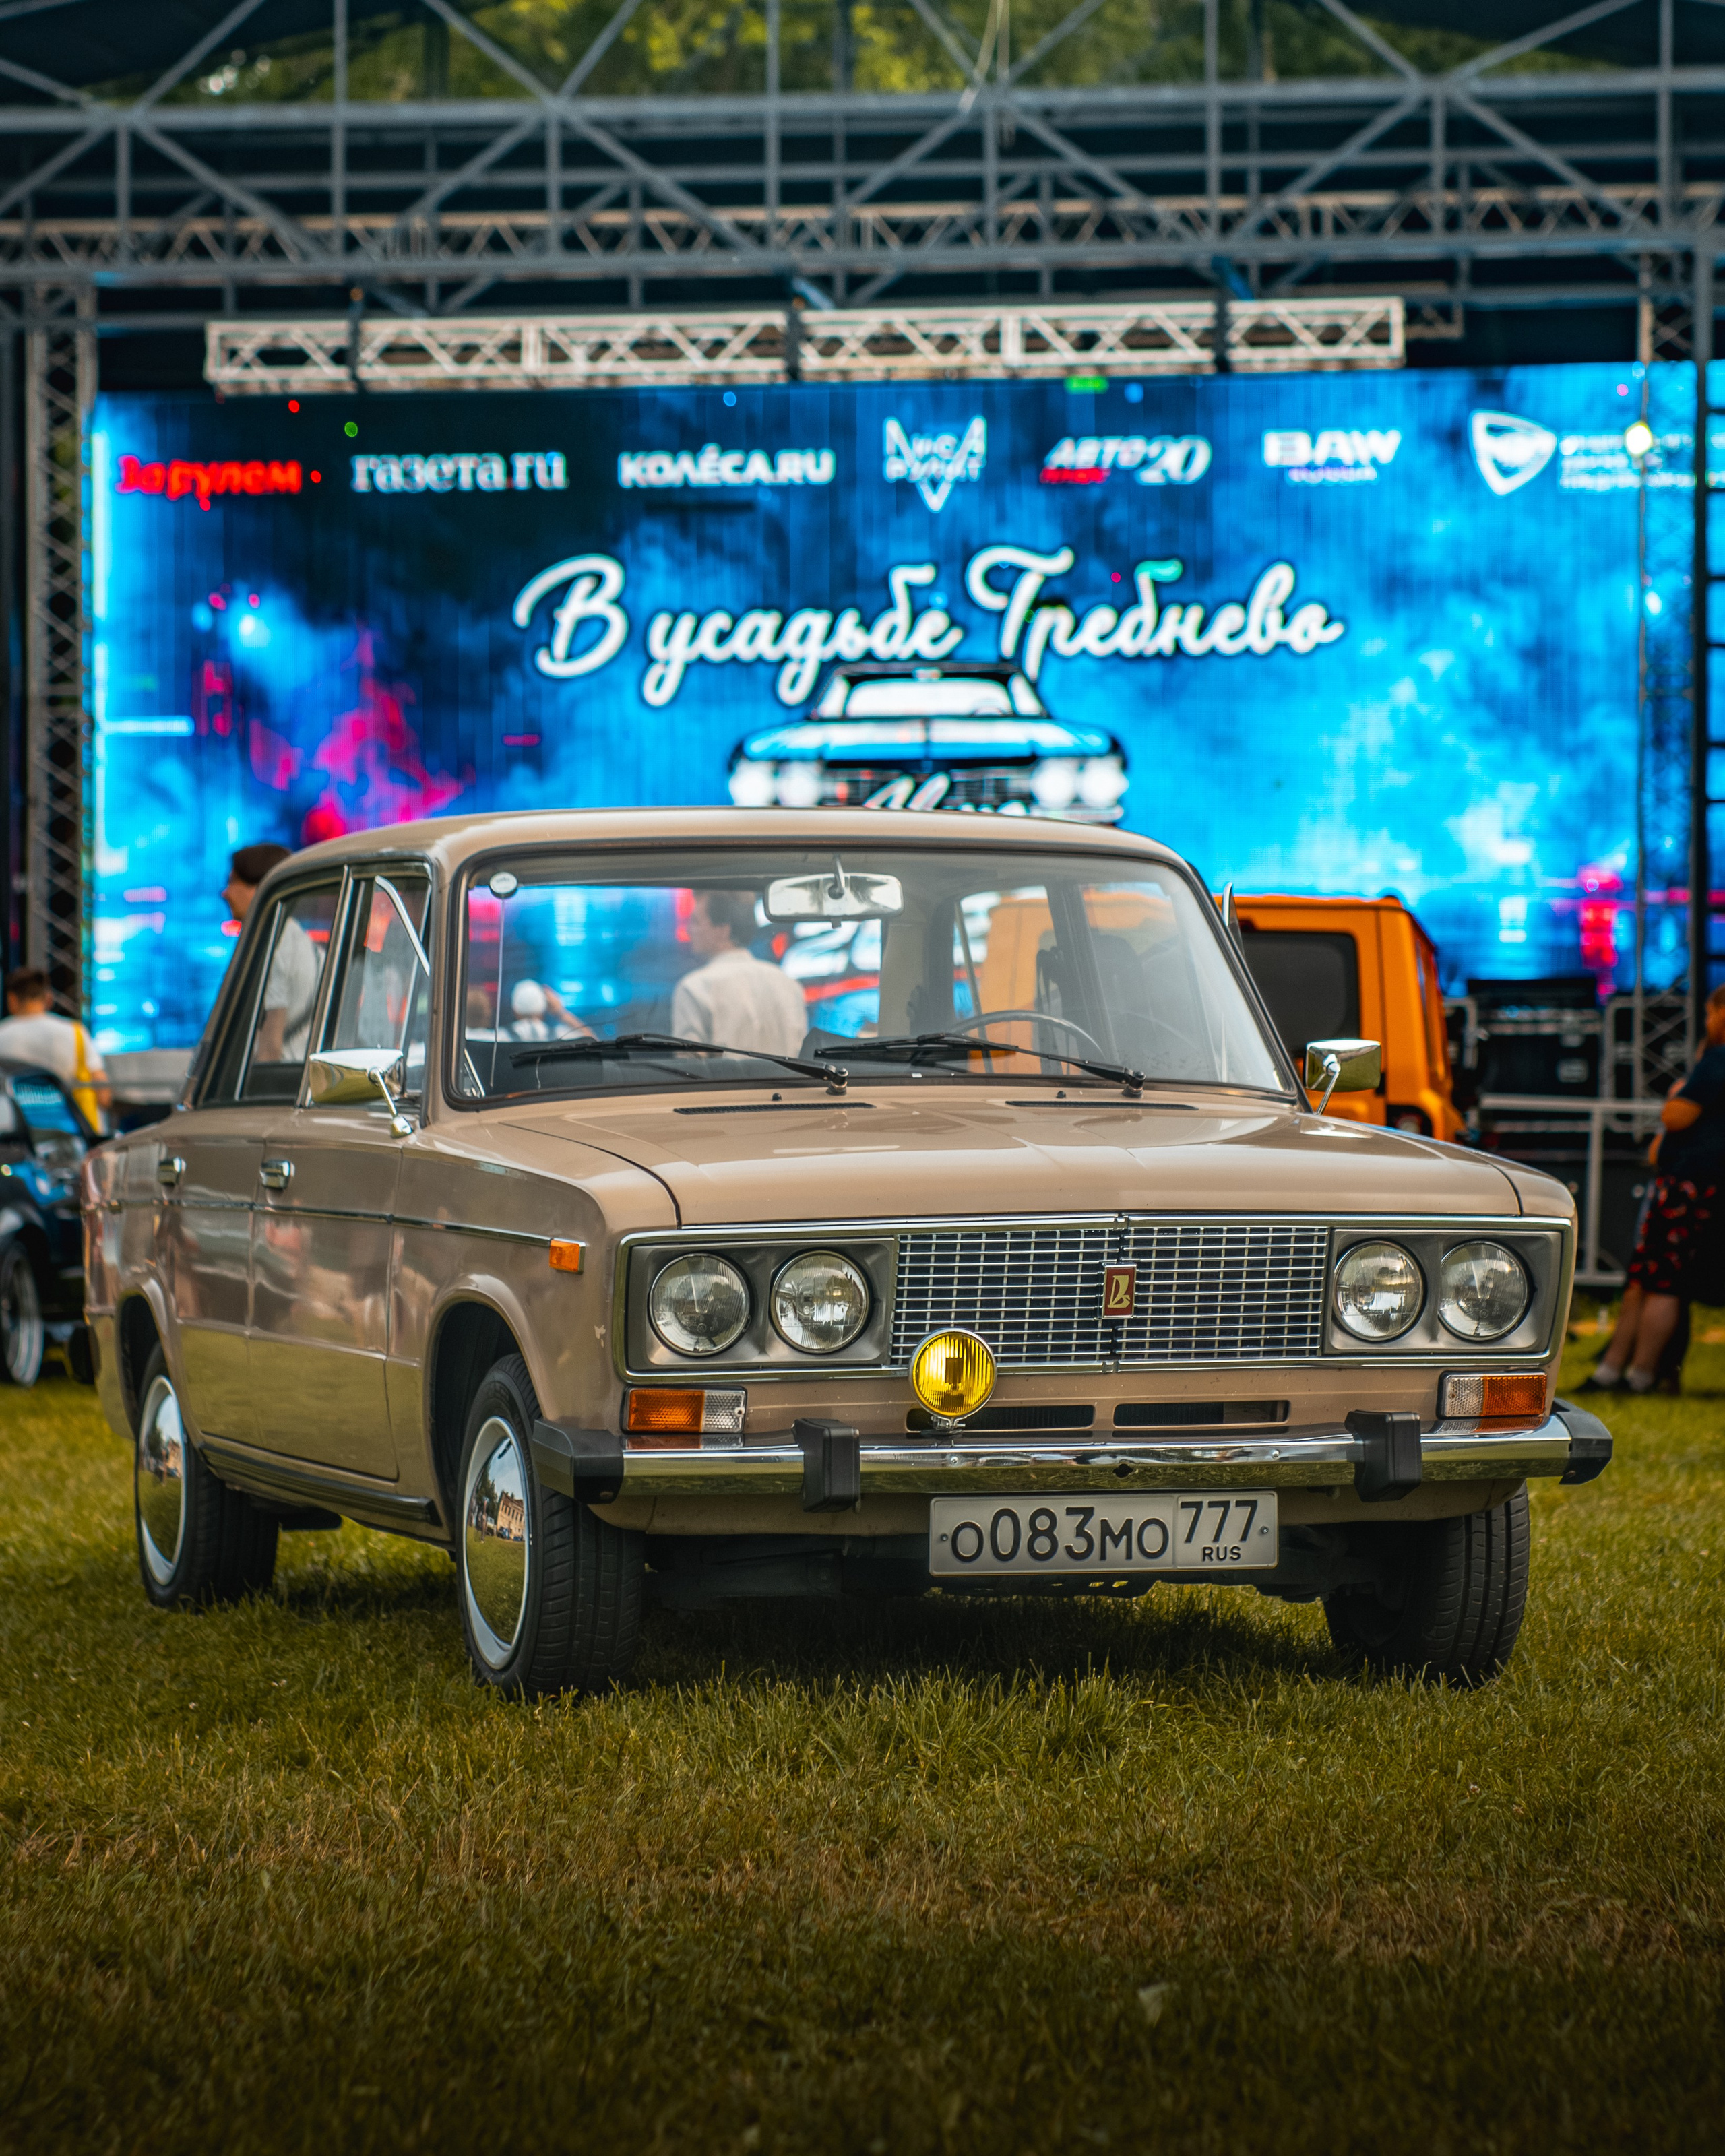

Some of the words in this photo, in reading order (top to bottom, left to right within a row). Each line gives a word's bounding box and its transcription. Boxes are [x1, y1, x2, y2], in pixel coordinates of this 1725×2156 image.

[1262, 428, 1402, 467] BAW
[513, 554, 628, 678] В
[641, 563, 962, 707] усадьбе
[1180, 1500, 1257, 1544] 777
[1202, 1546, 1241, 1562] RUS
